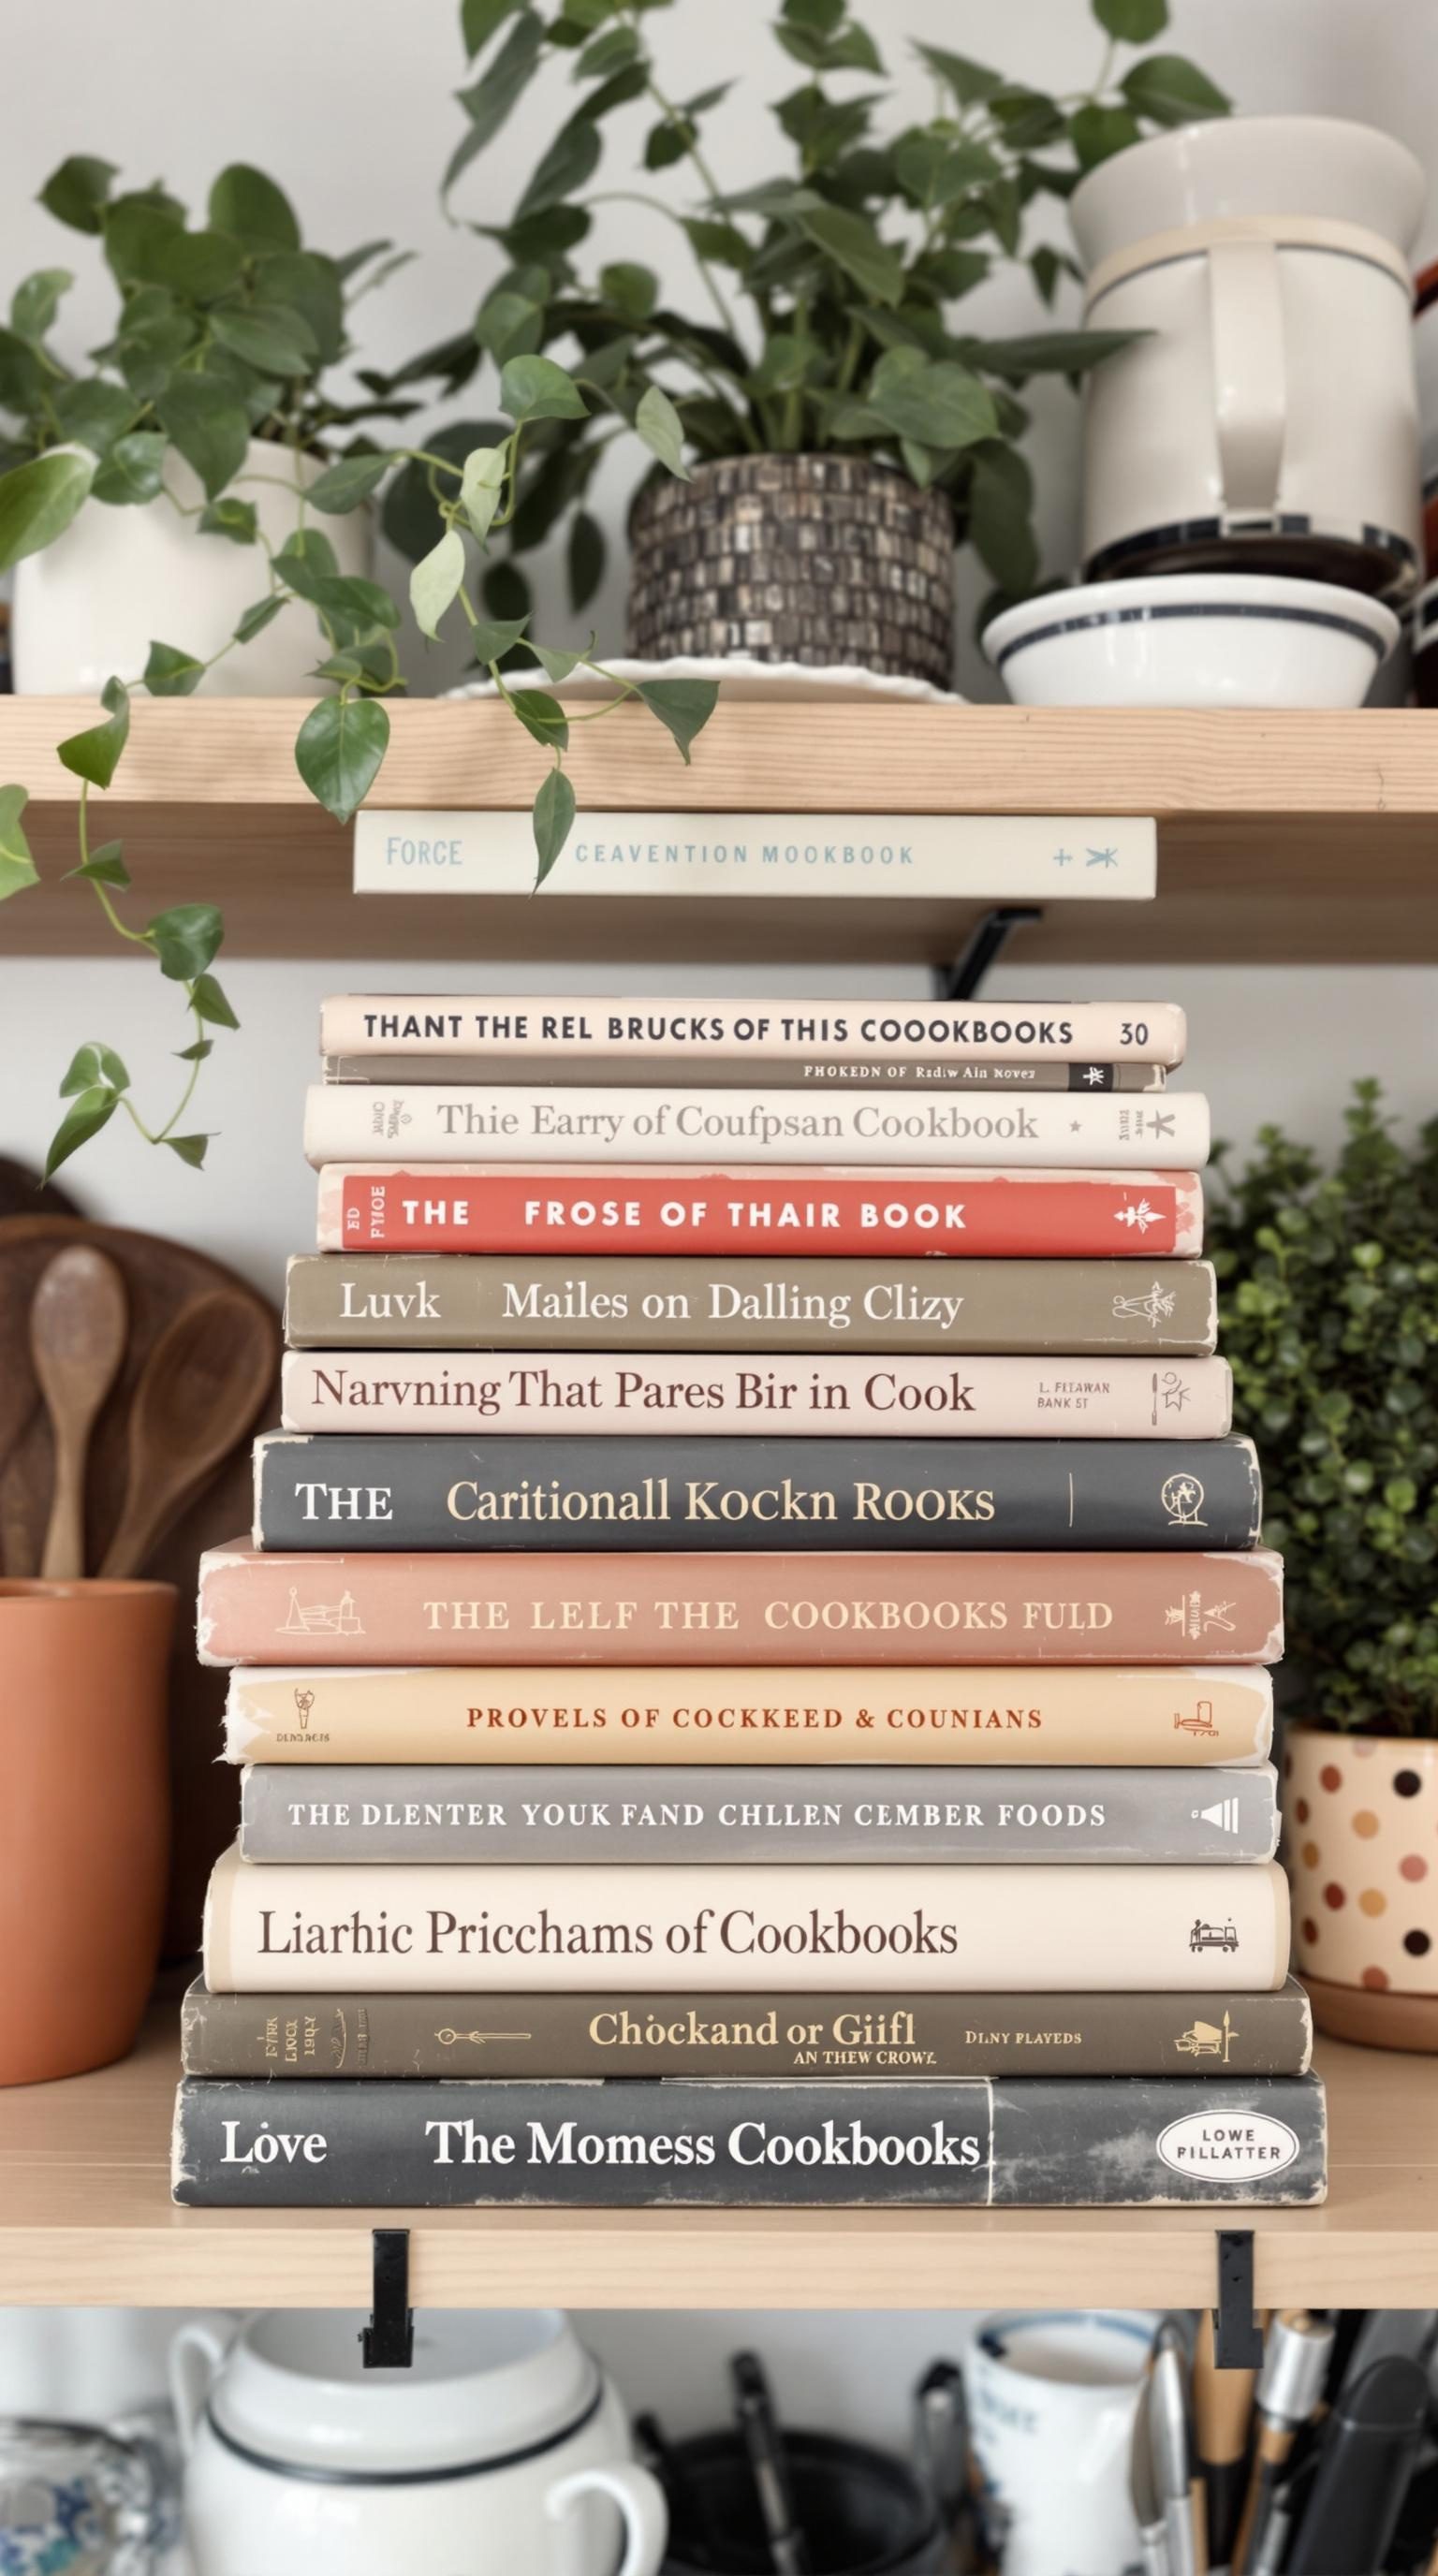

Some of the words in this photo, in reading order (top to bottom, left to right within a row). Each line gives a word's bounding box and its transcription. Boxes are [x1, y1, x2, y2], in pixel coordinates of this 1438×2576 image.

[387, 836, 462, 866] FORCE
[576, 843, 747, 864] CEAVENTION
[762, 845, 913, 865] MOOKBOOK
[363, 1014, 462, 1038] THANT
[475, 1015, 528, 1039] THE
[542, 1016, 593, 1040] REL
[608, 1017, 725, 1041] BRUCKS
[733, 1017, 770, 1041] OF
[780, 1018, 848, 1042] THIS
[860, 1018, 1073, 1045] COOOKBOOKS
[1120, 1022, 1149, 1046] 30
[804, 1065, 881, 1078] PHOKEDN
[887, 1066, 907, 1078] OF
[436, 1103, 520, 1135] Thie
[531, 1105, 624, 1144] Earry
[633, 1104, 672, 1135] of
[676, 1105, 844, 1145] Coufpsan
[853, 1106, 1039, 1139] Cookbook
[402, 1200, 469, 1225] THE
[525, 1200, 640, 1227] FROSE
[660, 1201, 707, 1227] OF
[726, 1202, 841, 1228] THAIR
[860, 1203, 966, 1229] BOOK
[339, 1280, 442, 1319] Luvk
[502, 1280, 628, 1319] Mailes
[641, 1295, 691, 1319] on
[708, 1282, 852, 1329] Dalling
[863, 1283, 964, 1330] Clizy
[311, 1369, 502, 1416] Narvning
[508, 1368, 603, 1408] That
[615, 1371, 725, 1409] Pares
[736, 1372, 798, 1410] Bir
[809, 1372, 851, 1410] in
[864, 1371, 976, 1412] Cook
[1037, 1397, 1072, 1409] BANK
[294, 1483, 393, 1520] THE
[447, 1477, 671, 1521] Caritionall
[684, 1478, 838, 1521] Kockn
[852, 1482, 995, 1521] ROOKS
[422, 1602, 509, 1630] THE
[530, 1602, 638, 1630] LELF
[653, 1602, 740, 1630] THE
[764, 1601, 1007, 1630] COOKBOOKS
[1022, 1602, 1113, 1630] FULD
[467, 1707, 607, 1728] PROVELS
[621, 1707, 660, 1728] OF
[672, 1708, 843, 1729] COCKKEED
[855, 1708, 875, 1729] &
[887, 1708, 1042, 1729] COUNIANS
[287, 1804, 350, 1826] THE
[360, 1804, 507, 1826] DLENTER
[521, 1803, 611, 1826] YOUK
[621, 1804, 704, 1826] FAND
[718, 1804, 843, 1826] CHLLEN
[854, 1804, 985, 1826] CEMBER
[998, 1804, 1106, 1827] FOODS
[257, 1910, 413, 1954] Liarhic
[426, 1909, 653, 1954] Pricchams
[666, 1909, 715, 1954] of
[720, 1909, 958, 1954] Cookbooks
[786, 2024, 824, 2045] or
[793, 2051, 818, 2065] AN
[822, 2051, 870, 2065] THEW
[424, 2118, 516, 2165] The
[526, 2121, 716, 2165] Momess
[727, 2119, 981, 2167] Cookbooks
[1202, 2129, 1255, 2142] LOWE
[1177, 2145, 1281, 2159] PILLATTER
